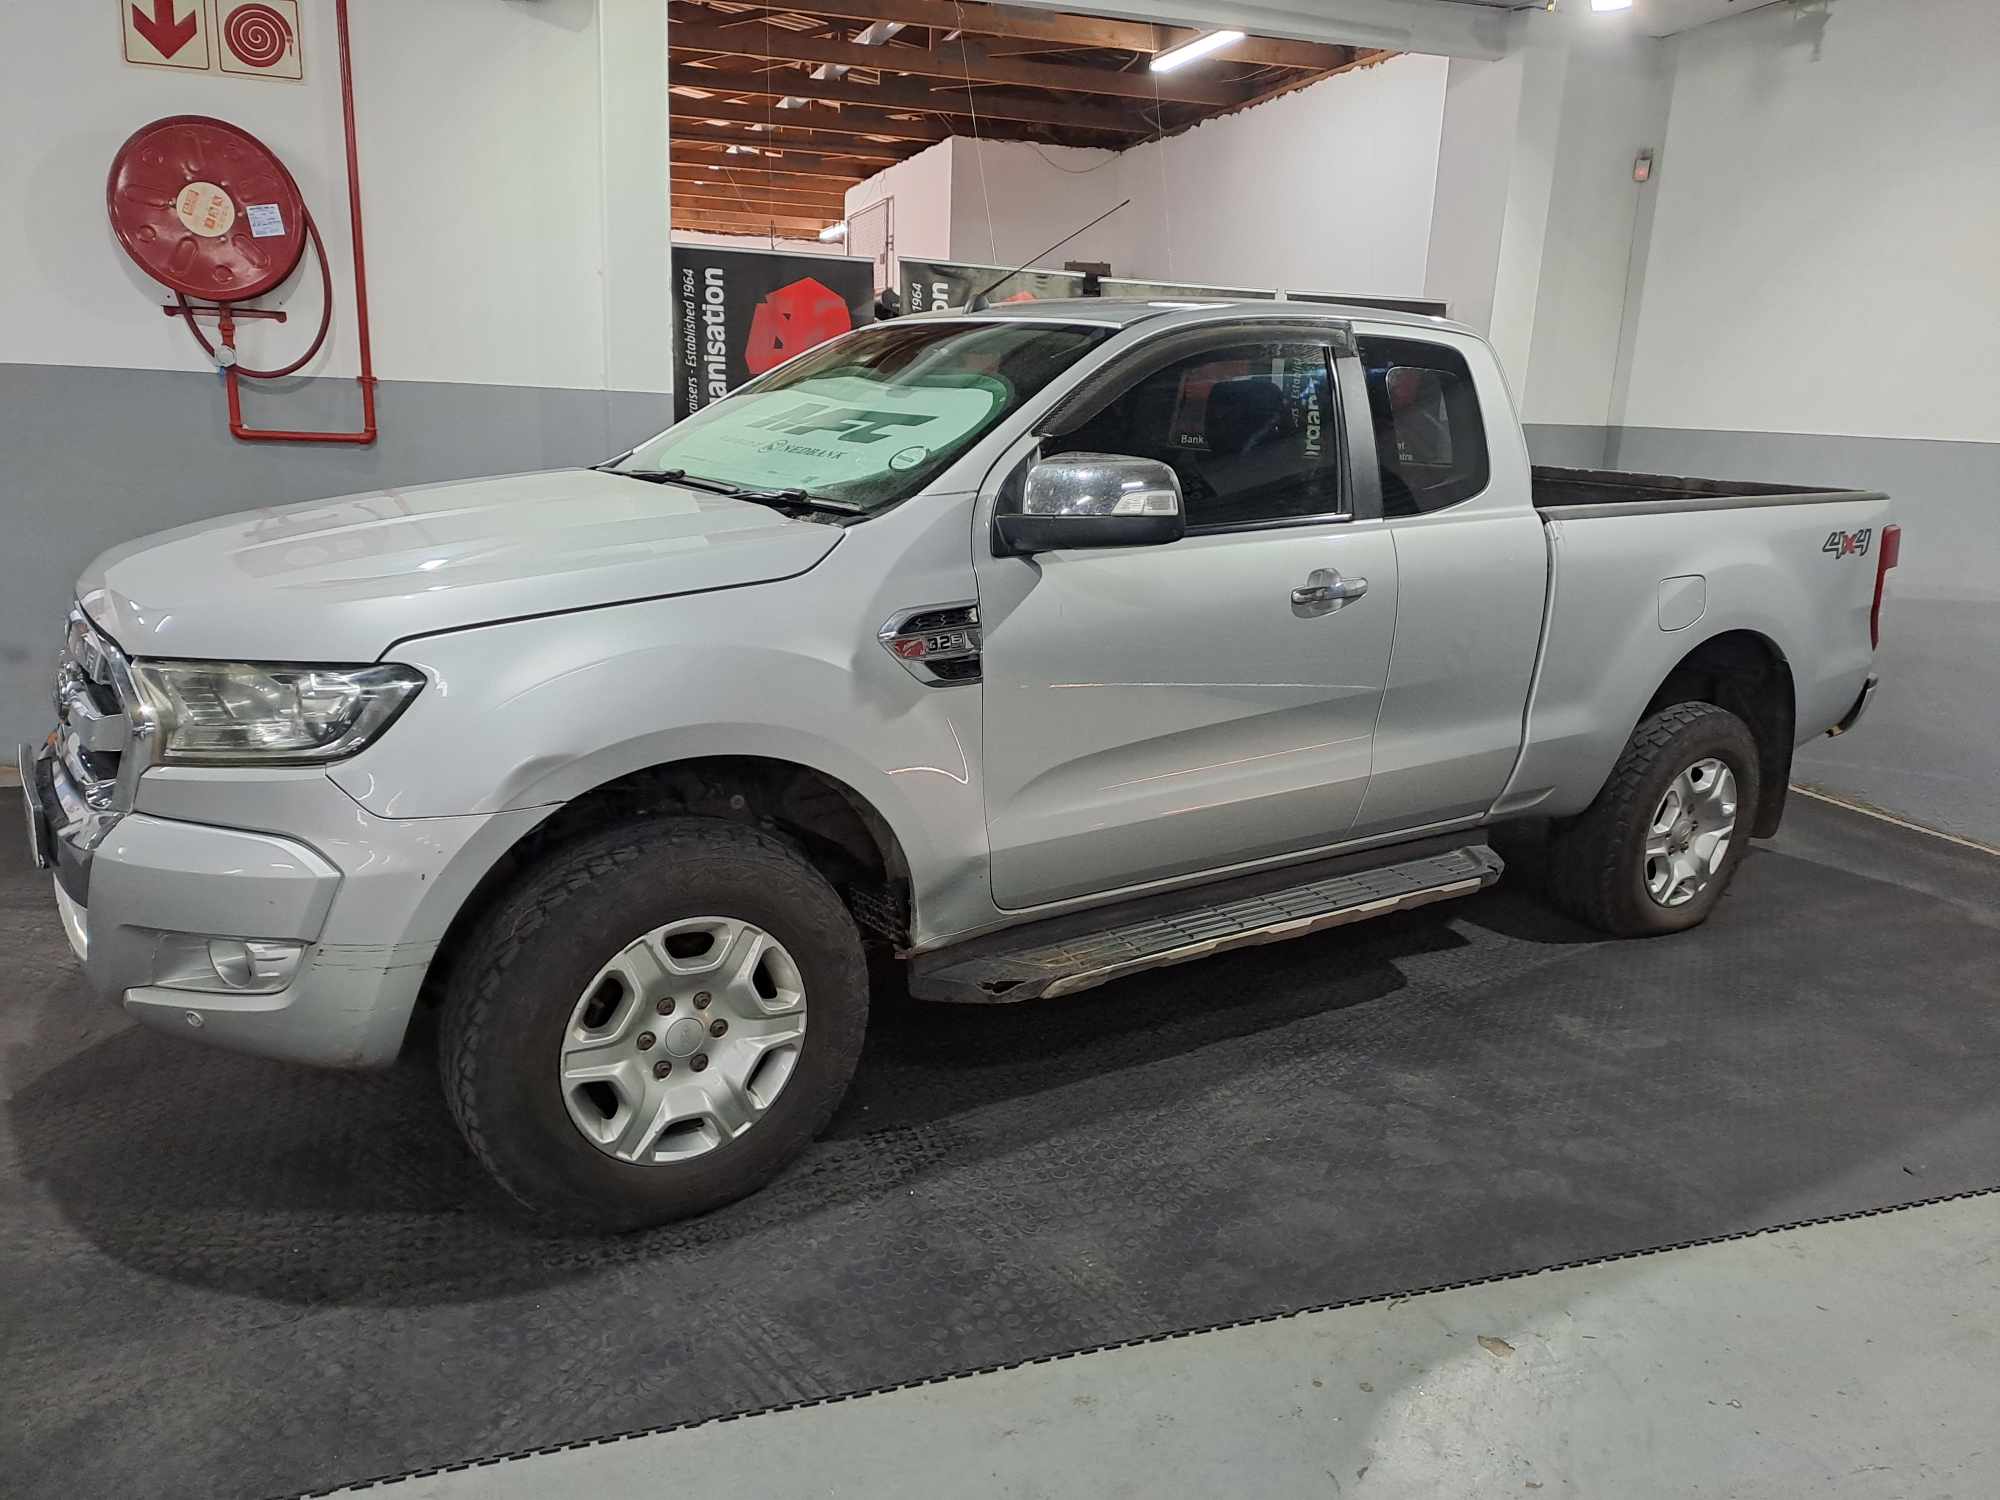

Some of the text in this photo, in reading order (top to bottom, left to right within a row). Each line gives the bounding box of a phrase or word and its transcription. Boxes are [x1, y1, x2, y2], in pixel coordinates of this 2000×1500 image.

[682, 268, 695, 298] 1964
[911, 282, 923, 311] 1964
[683, 300, 697, 367] Established
[702, 267, 728, 402] anisation
[1180, 433, 1204, 445] Bank
